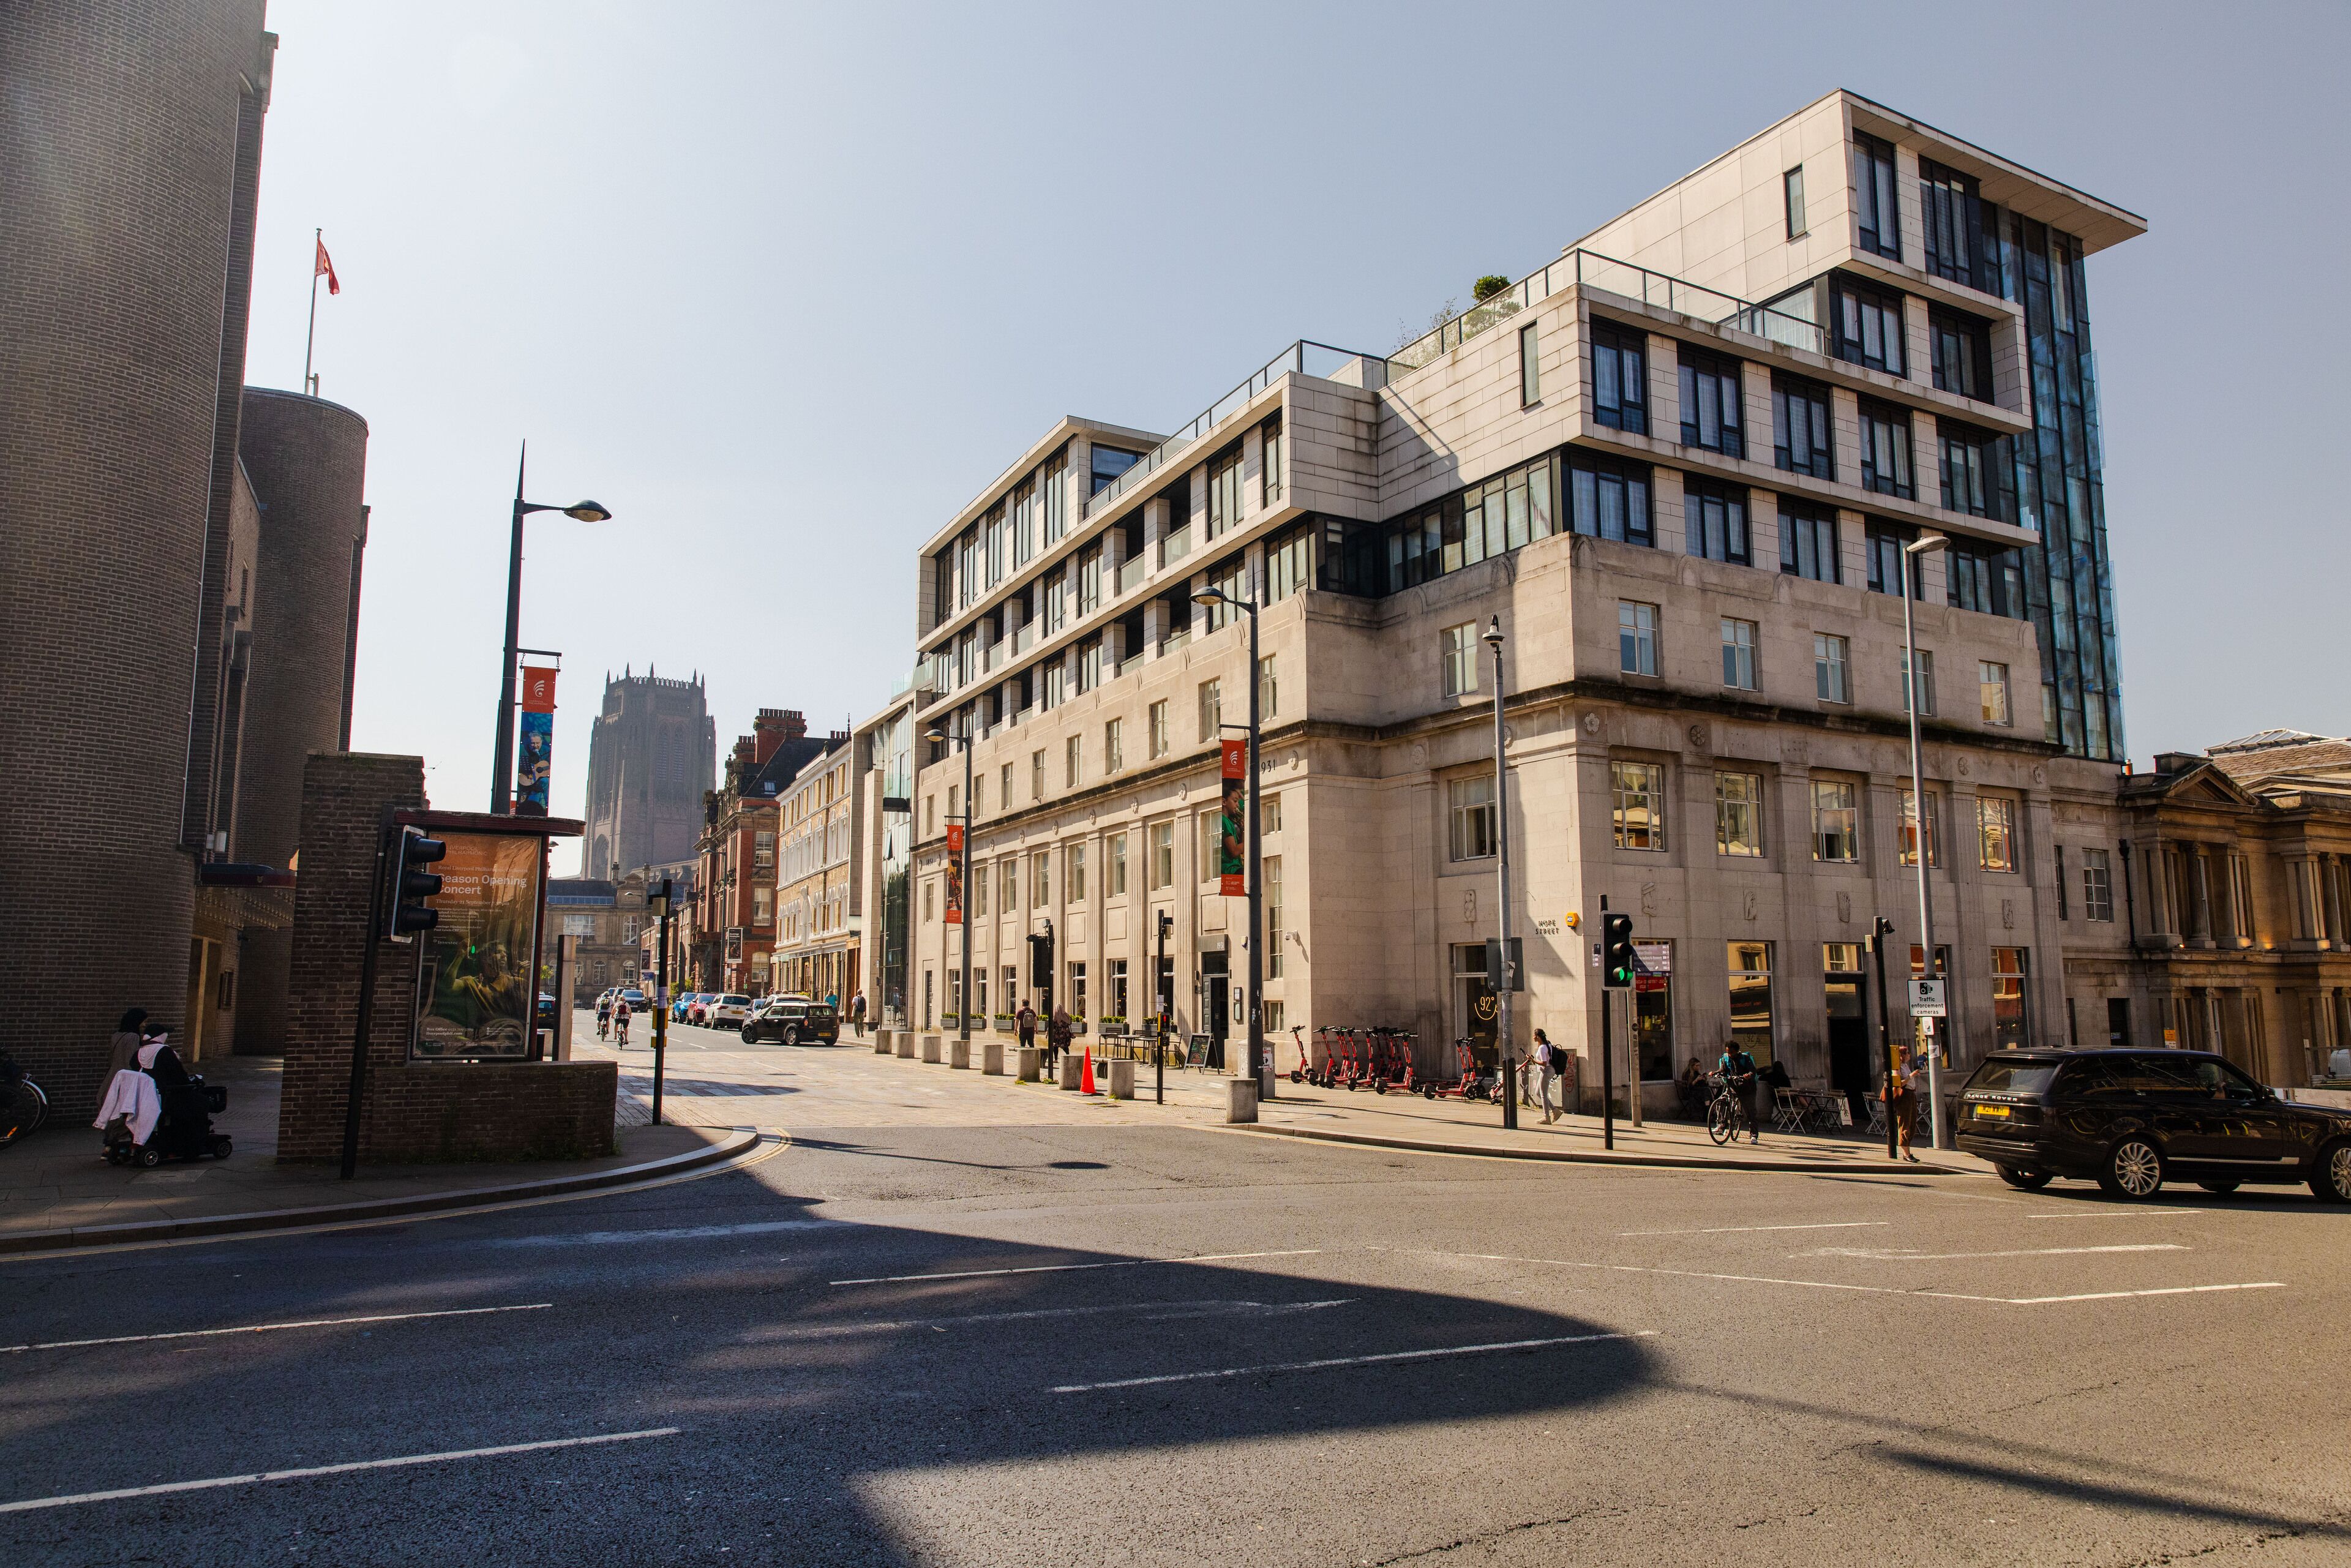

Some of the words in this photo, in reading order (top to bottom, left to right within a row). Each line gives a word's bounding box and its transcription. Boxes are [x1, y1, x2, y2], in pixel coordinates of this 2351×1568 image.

[1261, 759, 1275, 775] 931
[438, 873, 479, 883] Season
[481, 875, 527, 888] Opening
